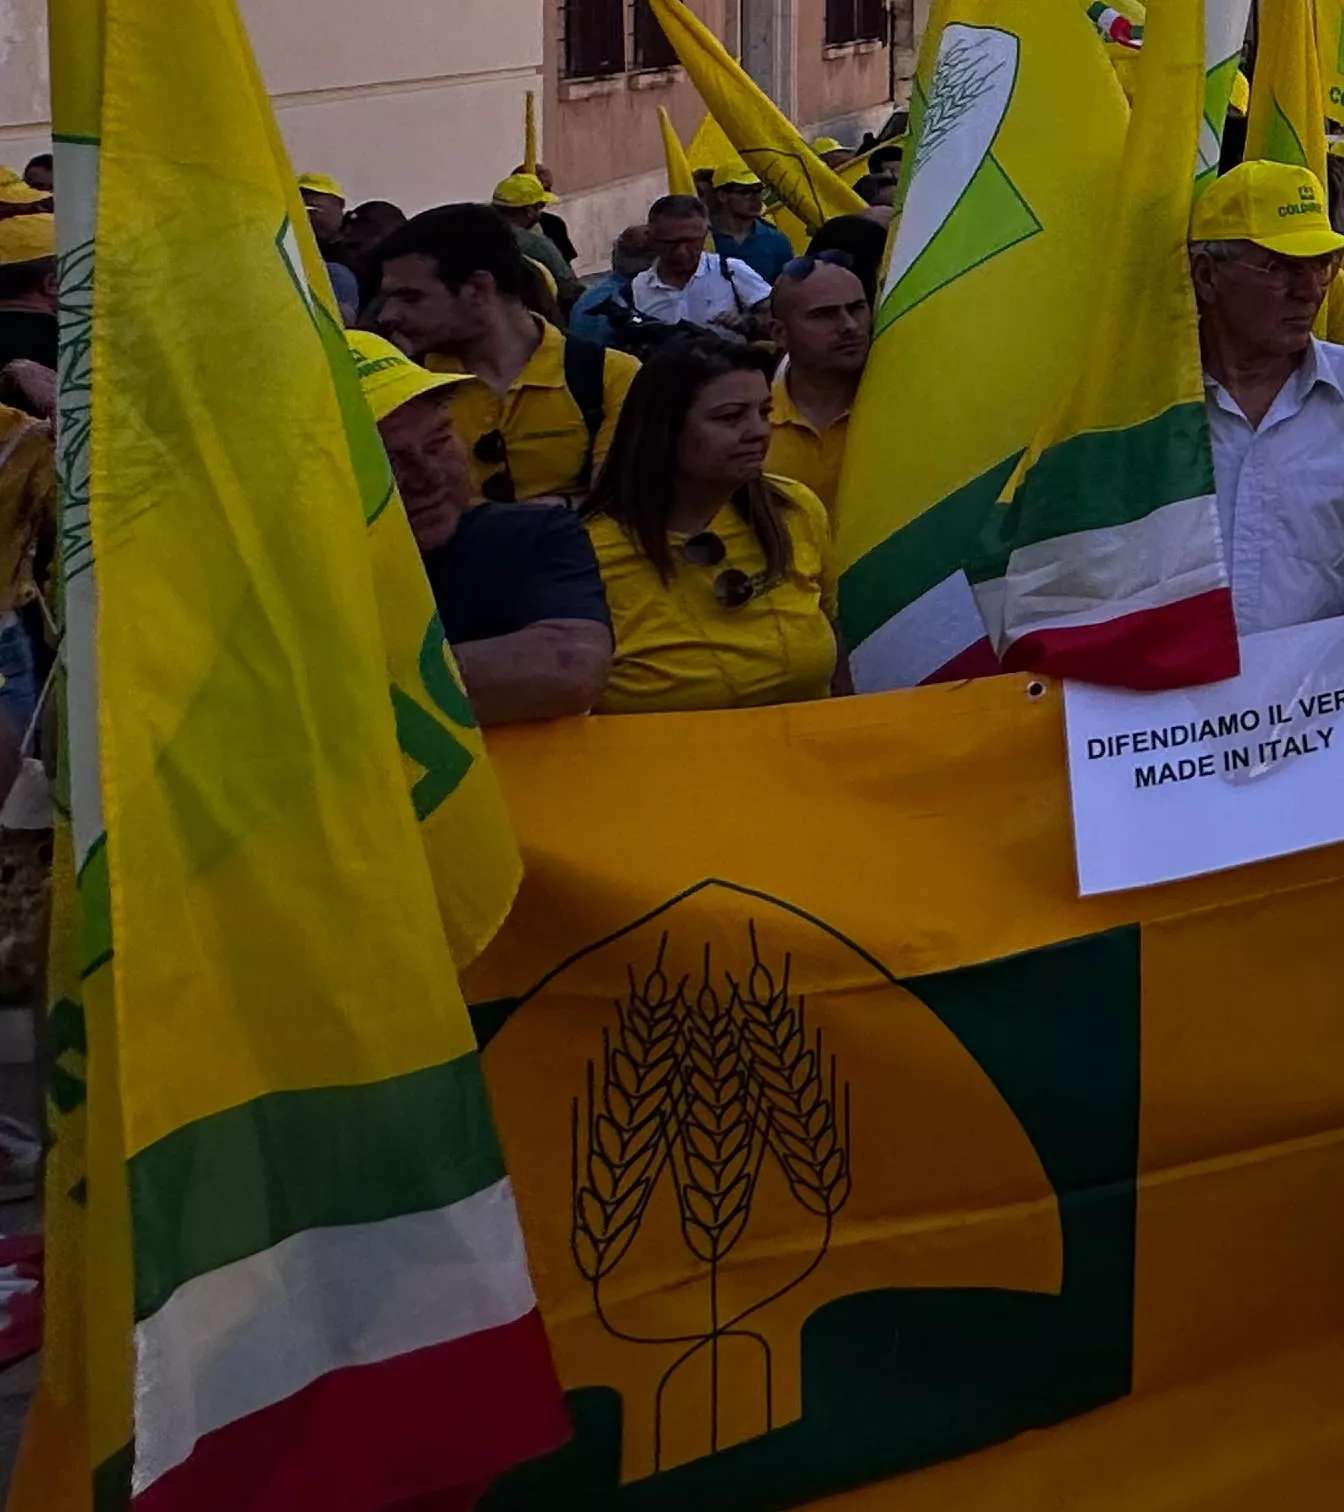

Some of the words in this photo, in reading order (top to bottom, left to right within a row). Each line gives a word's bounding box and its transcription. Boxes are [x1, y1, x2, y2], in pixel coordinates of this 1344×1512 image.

[1087, 710, 1260, 760] DIFENDIAMO
[1268, 704, 1292, 725] IL
[1134, 755, 1215, 788] MADE
[1223, 747, 1250, 771] IN
[1258, 727, 1334, 764] ITALY
